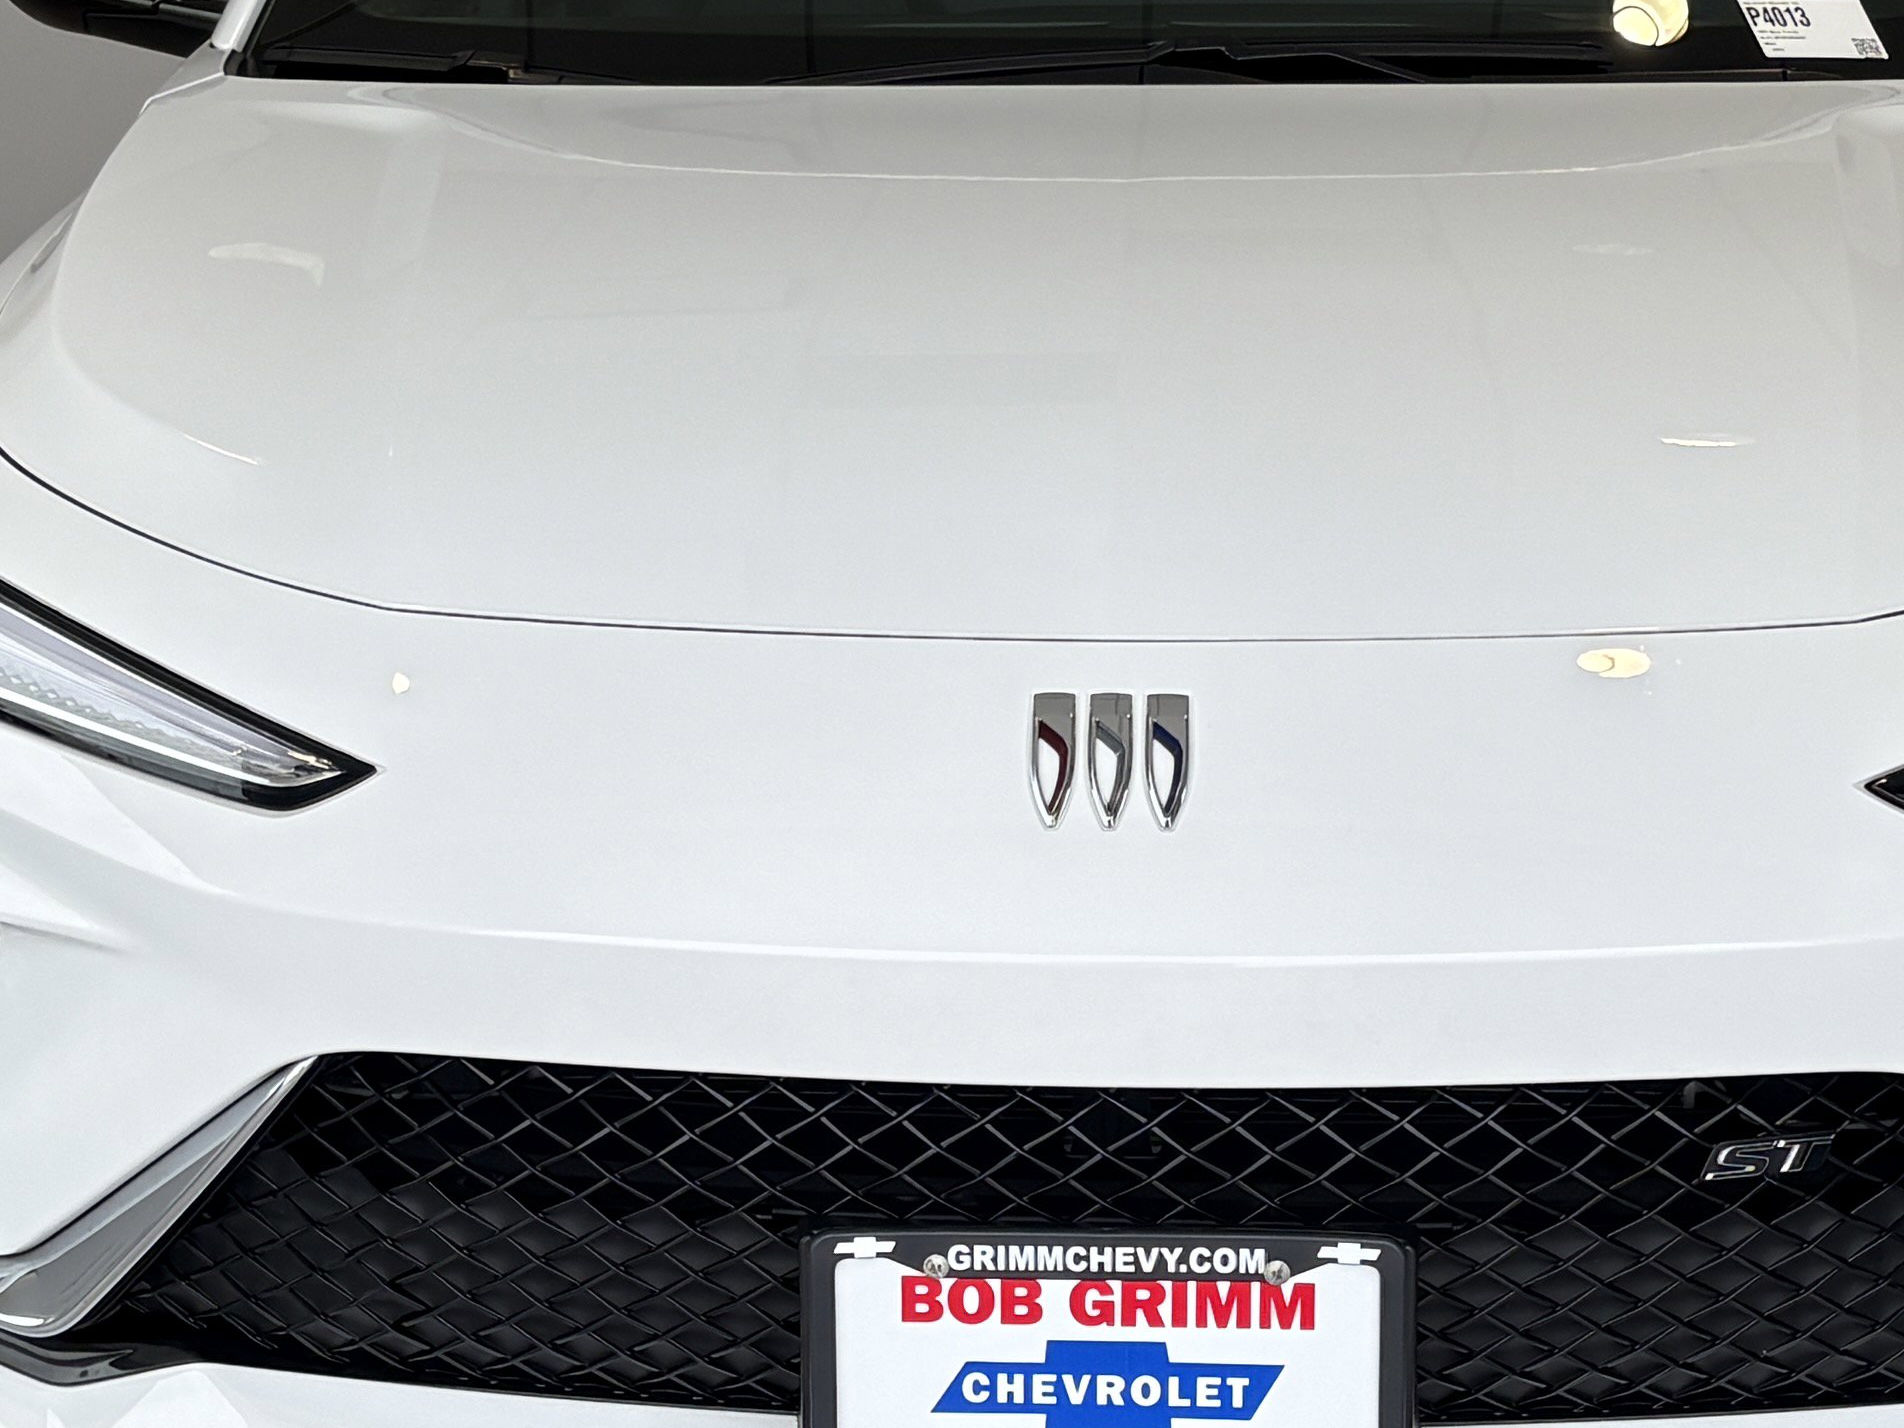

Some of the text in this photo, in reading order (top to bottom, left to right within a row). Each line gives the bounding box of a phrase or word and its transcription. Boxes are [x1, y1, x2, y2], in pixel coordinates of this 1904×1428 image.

[1745, 6, 1812, 28] P4013
[947, 1243, 1266, 1276] GRIMMCHEVY.COM
[901, 1276, 1316, 1331] BOB GRIMM
[961, 1371, 1251, 1410] CHEVROLET
